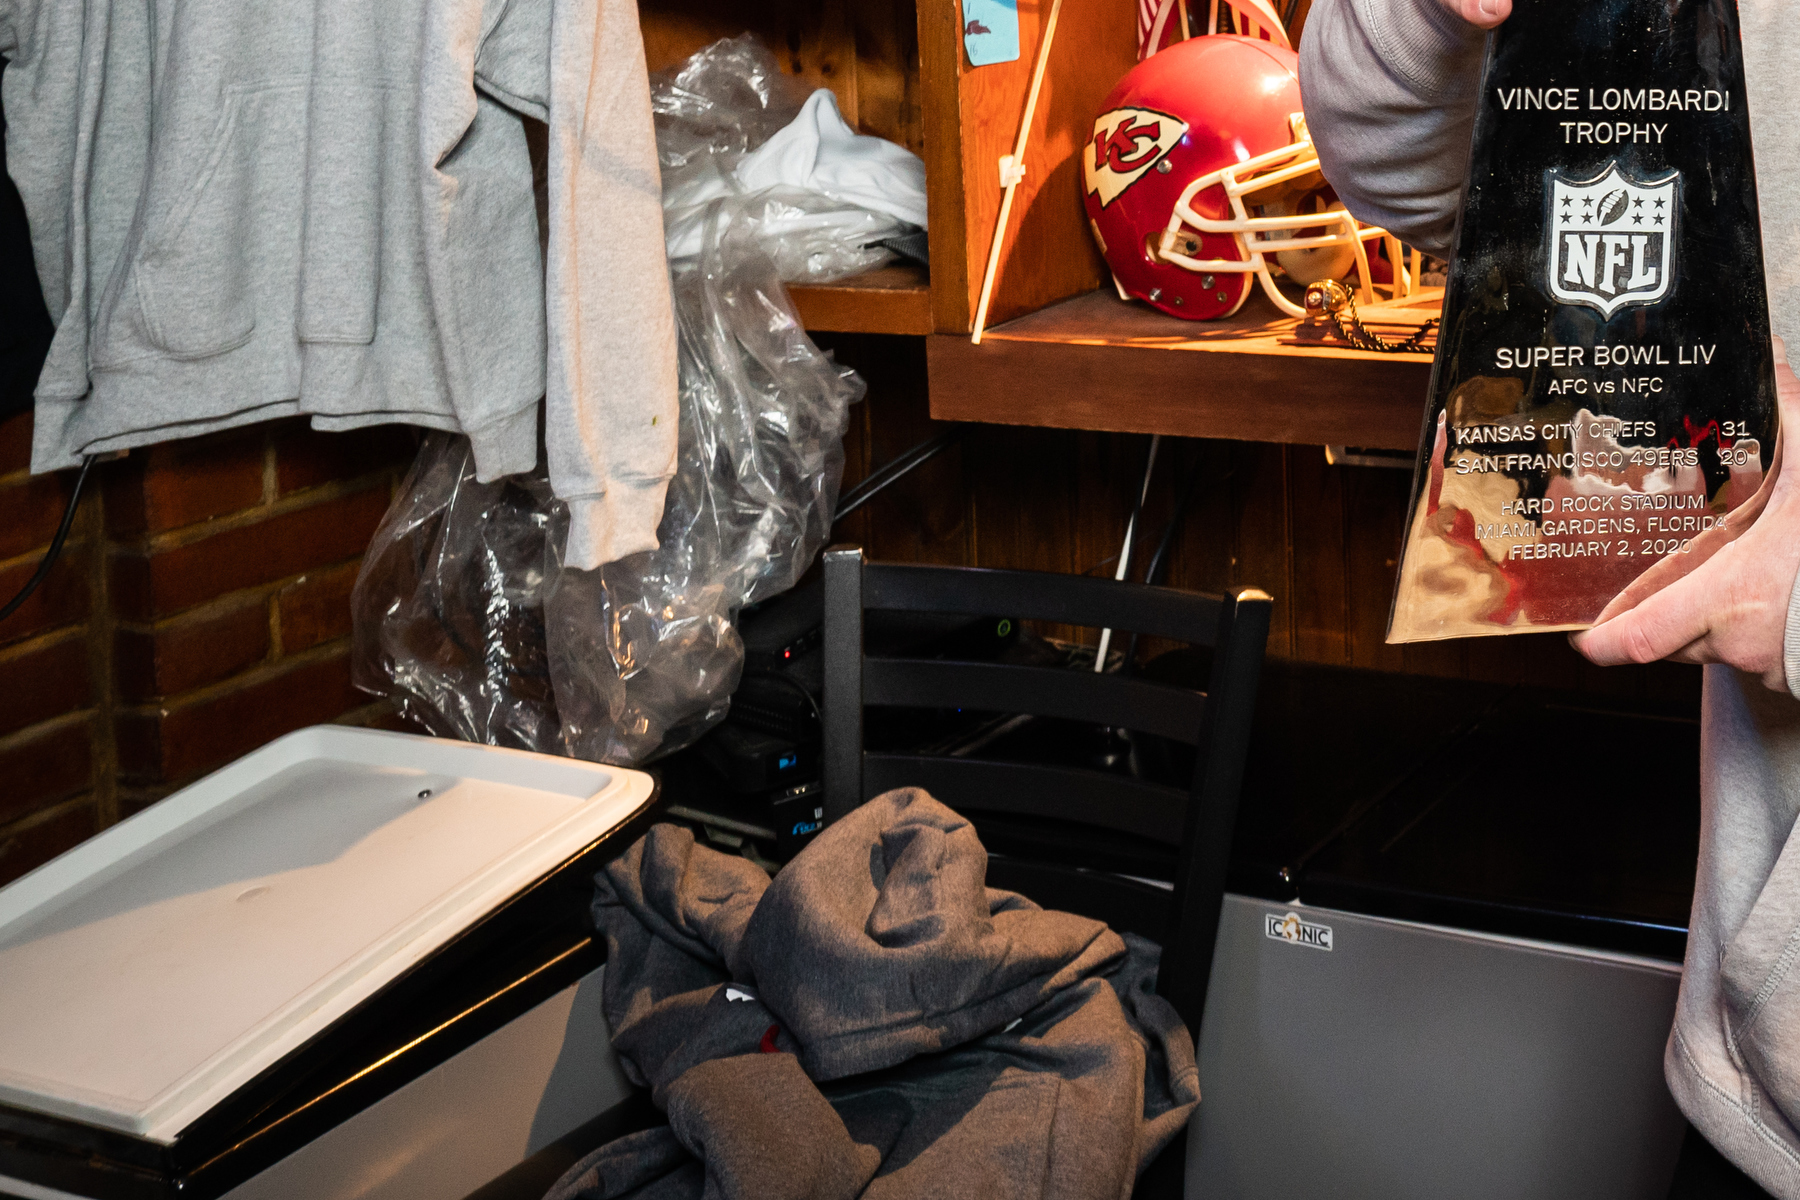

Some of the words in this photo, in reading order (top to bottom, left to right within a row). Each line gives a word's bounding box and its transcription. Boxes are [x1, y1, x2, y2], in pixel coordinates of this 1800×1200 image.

[1497, 87, 1581, 113] VINCE
[1588, 87, 1731, 113] LOMBARDI
[1559, 121, 1669, 145] TROPHY
[1562, 232, 1660, 296] NFL
[1494, 345, 1585, 370] SUPER
[1594, 345, 1671, 367] BOWL
[1677, 343, 1717, 366] LIV
[1547, 378, 1588, 396] AFC
[1593, 380, 1616, 394] vs
[1621, 376, 1664, 394] NFC
[1456, 424, 1537, 446] KANSAS
[1541, 422, 1585, 442] CITY
[1587, 420, 1657, 441] CHIEFS
[1720, 419, 1750, 439] 31
[1455, 455, 1501, 475] SAN
[1504, 451, 1624, 473] FRANCISCO
[1630, 448, 1700, 469] 49ERS
[1719, 448, 1749, 468] 20
[1500, 496, 1556, 518] HARD
[1560, 494, 1615, 514] ROCK
[1618, 493, 1706, 512] STADIUM
[1475, 521, 1538, 542] MIAMI
[1541, 517, 1642, 539] GARDENS,
[1647, 515, 1729, 535] FLORIDA
[1509, 539, 1613, 562] FEBRUARY
[1616, 539, 1637, 559] 2,
[1641, 537, 1694, 558] 2020
